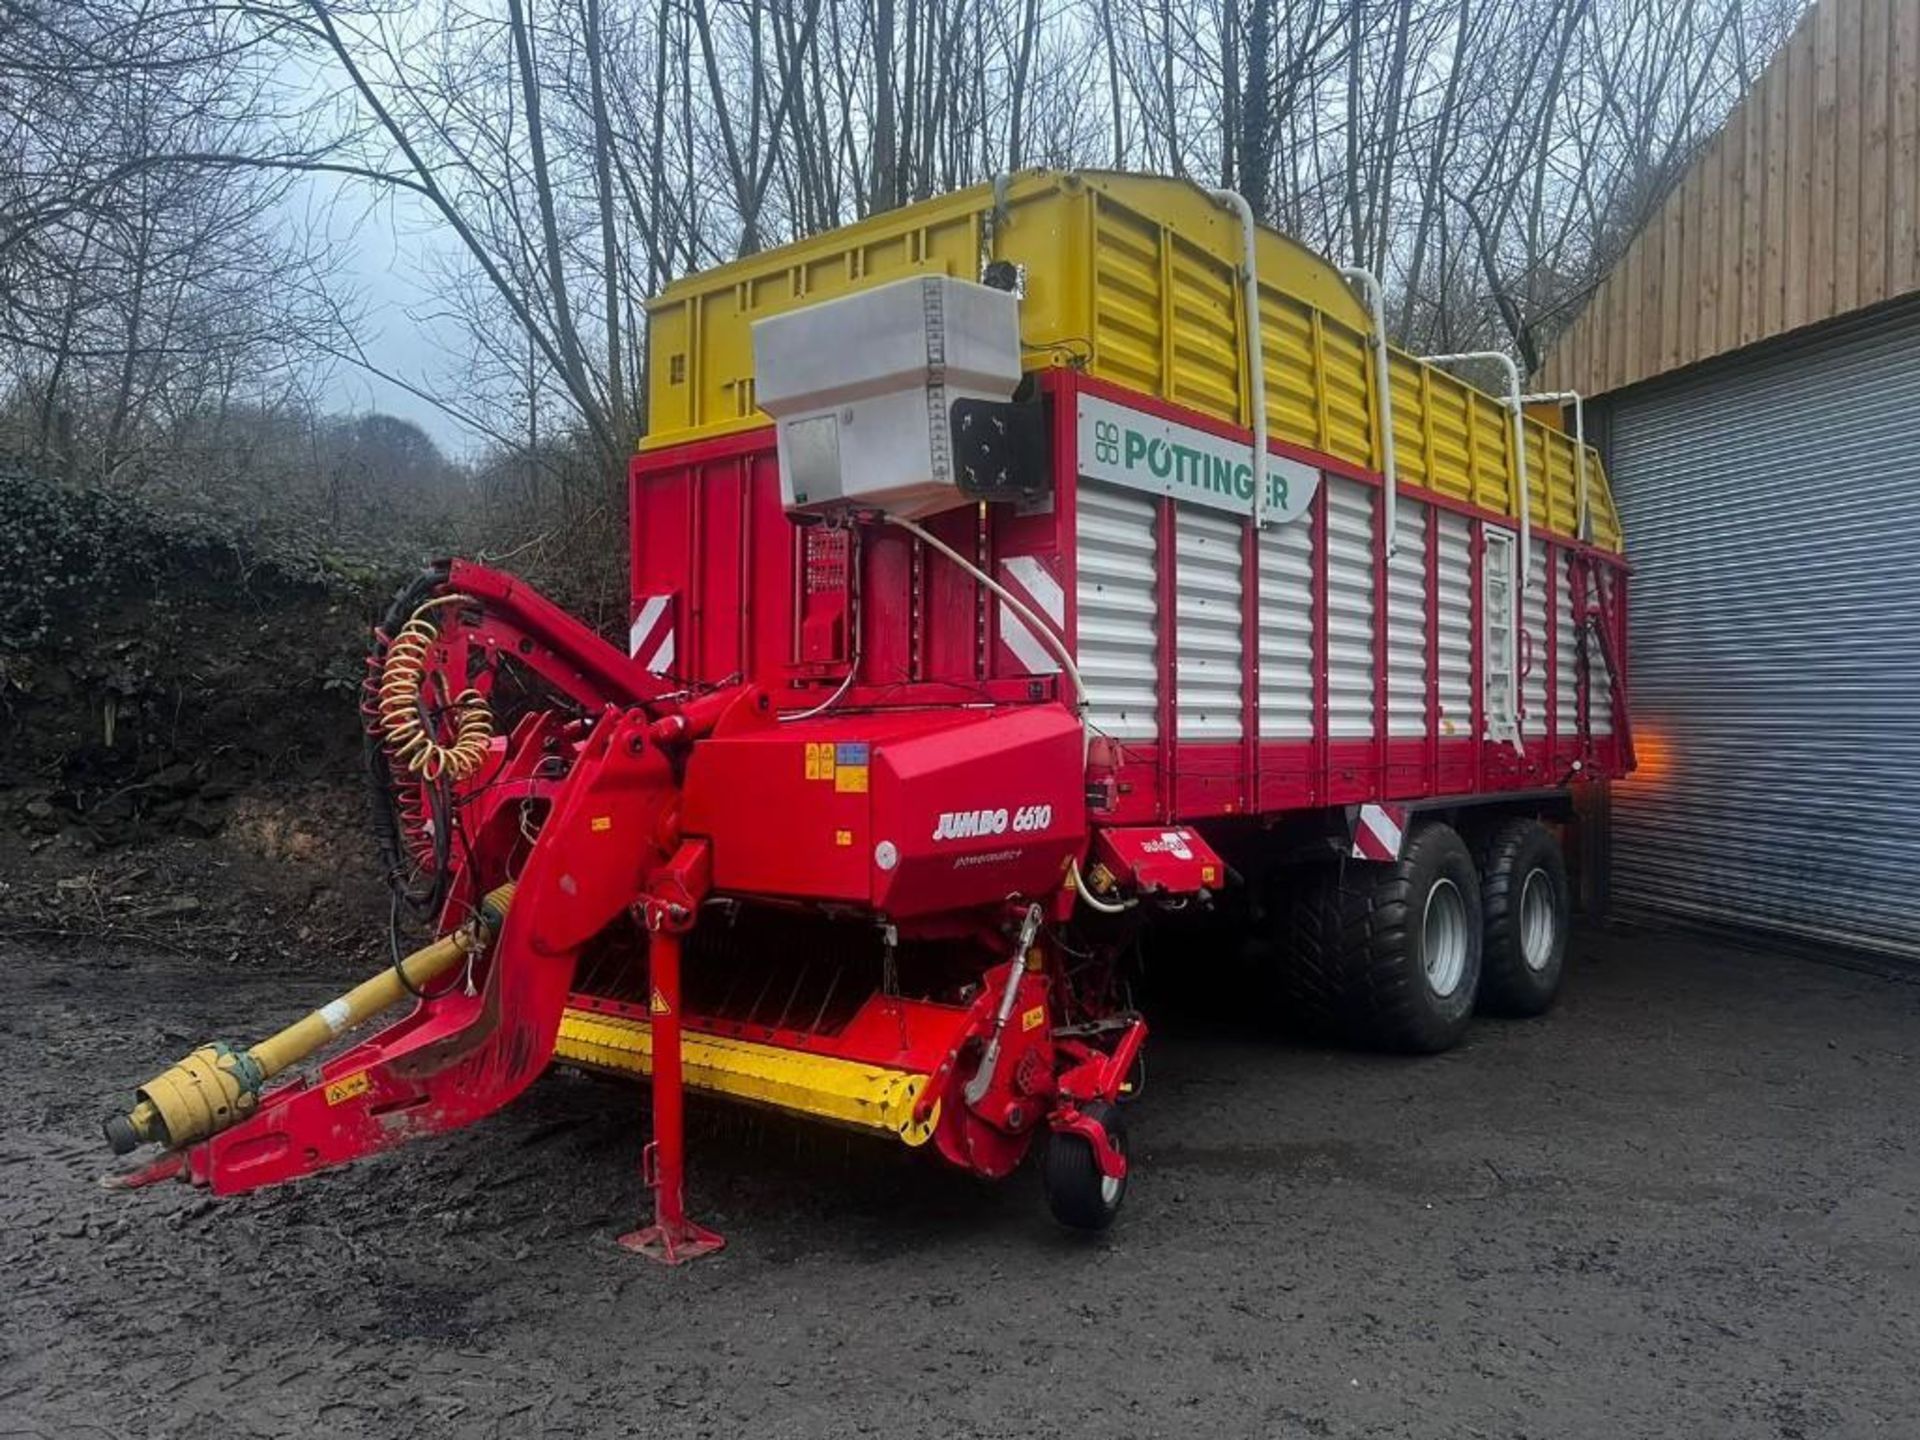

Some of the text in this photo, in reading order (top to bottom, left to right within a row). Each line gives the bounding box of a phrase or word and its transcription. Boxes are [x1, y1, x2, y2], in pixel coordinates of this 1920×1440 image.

[1125, 429, 1289, 510] PÖTTINGR
[932, 804, 1051, 840] JUMBO 6610
